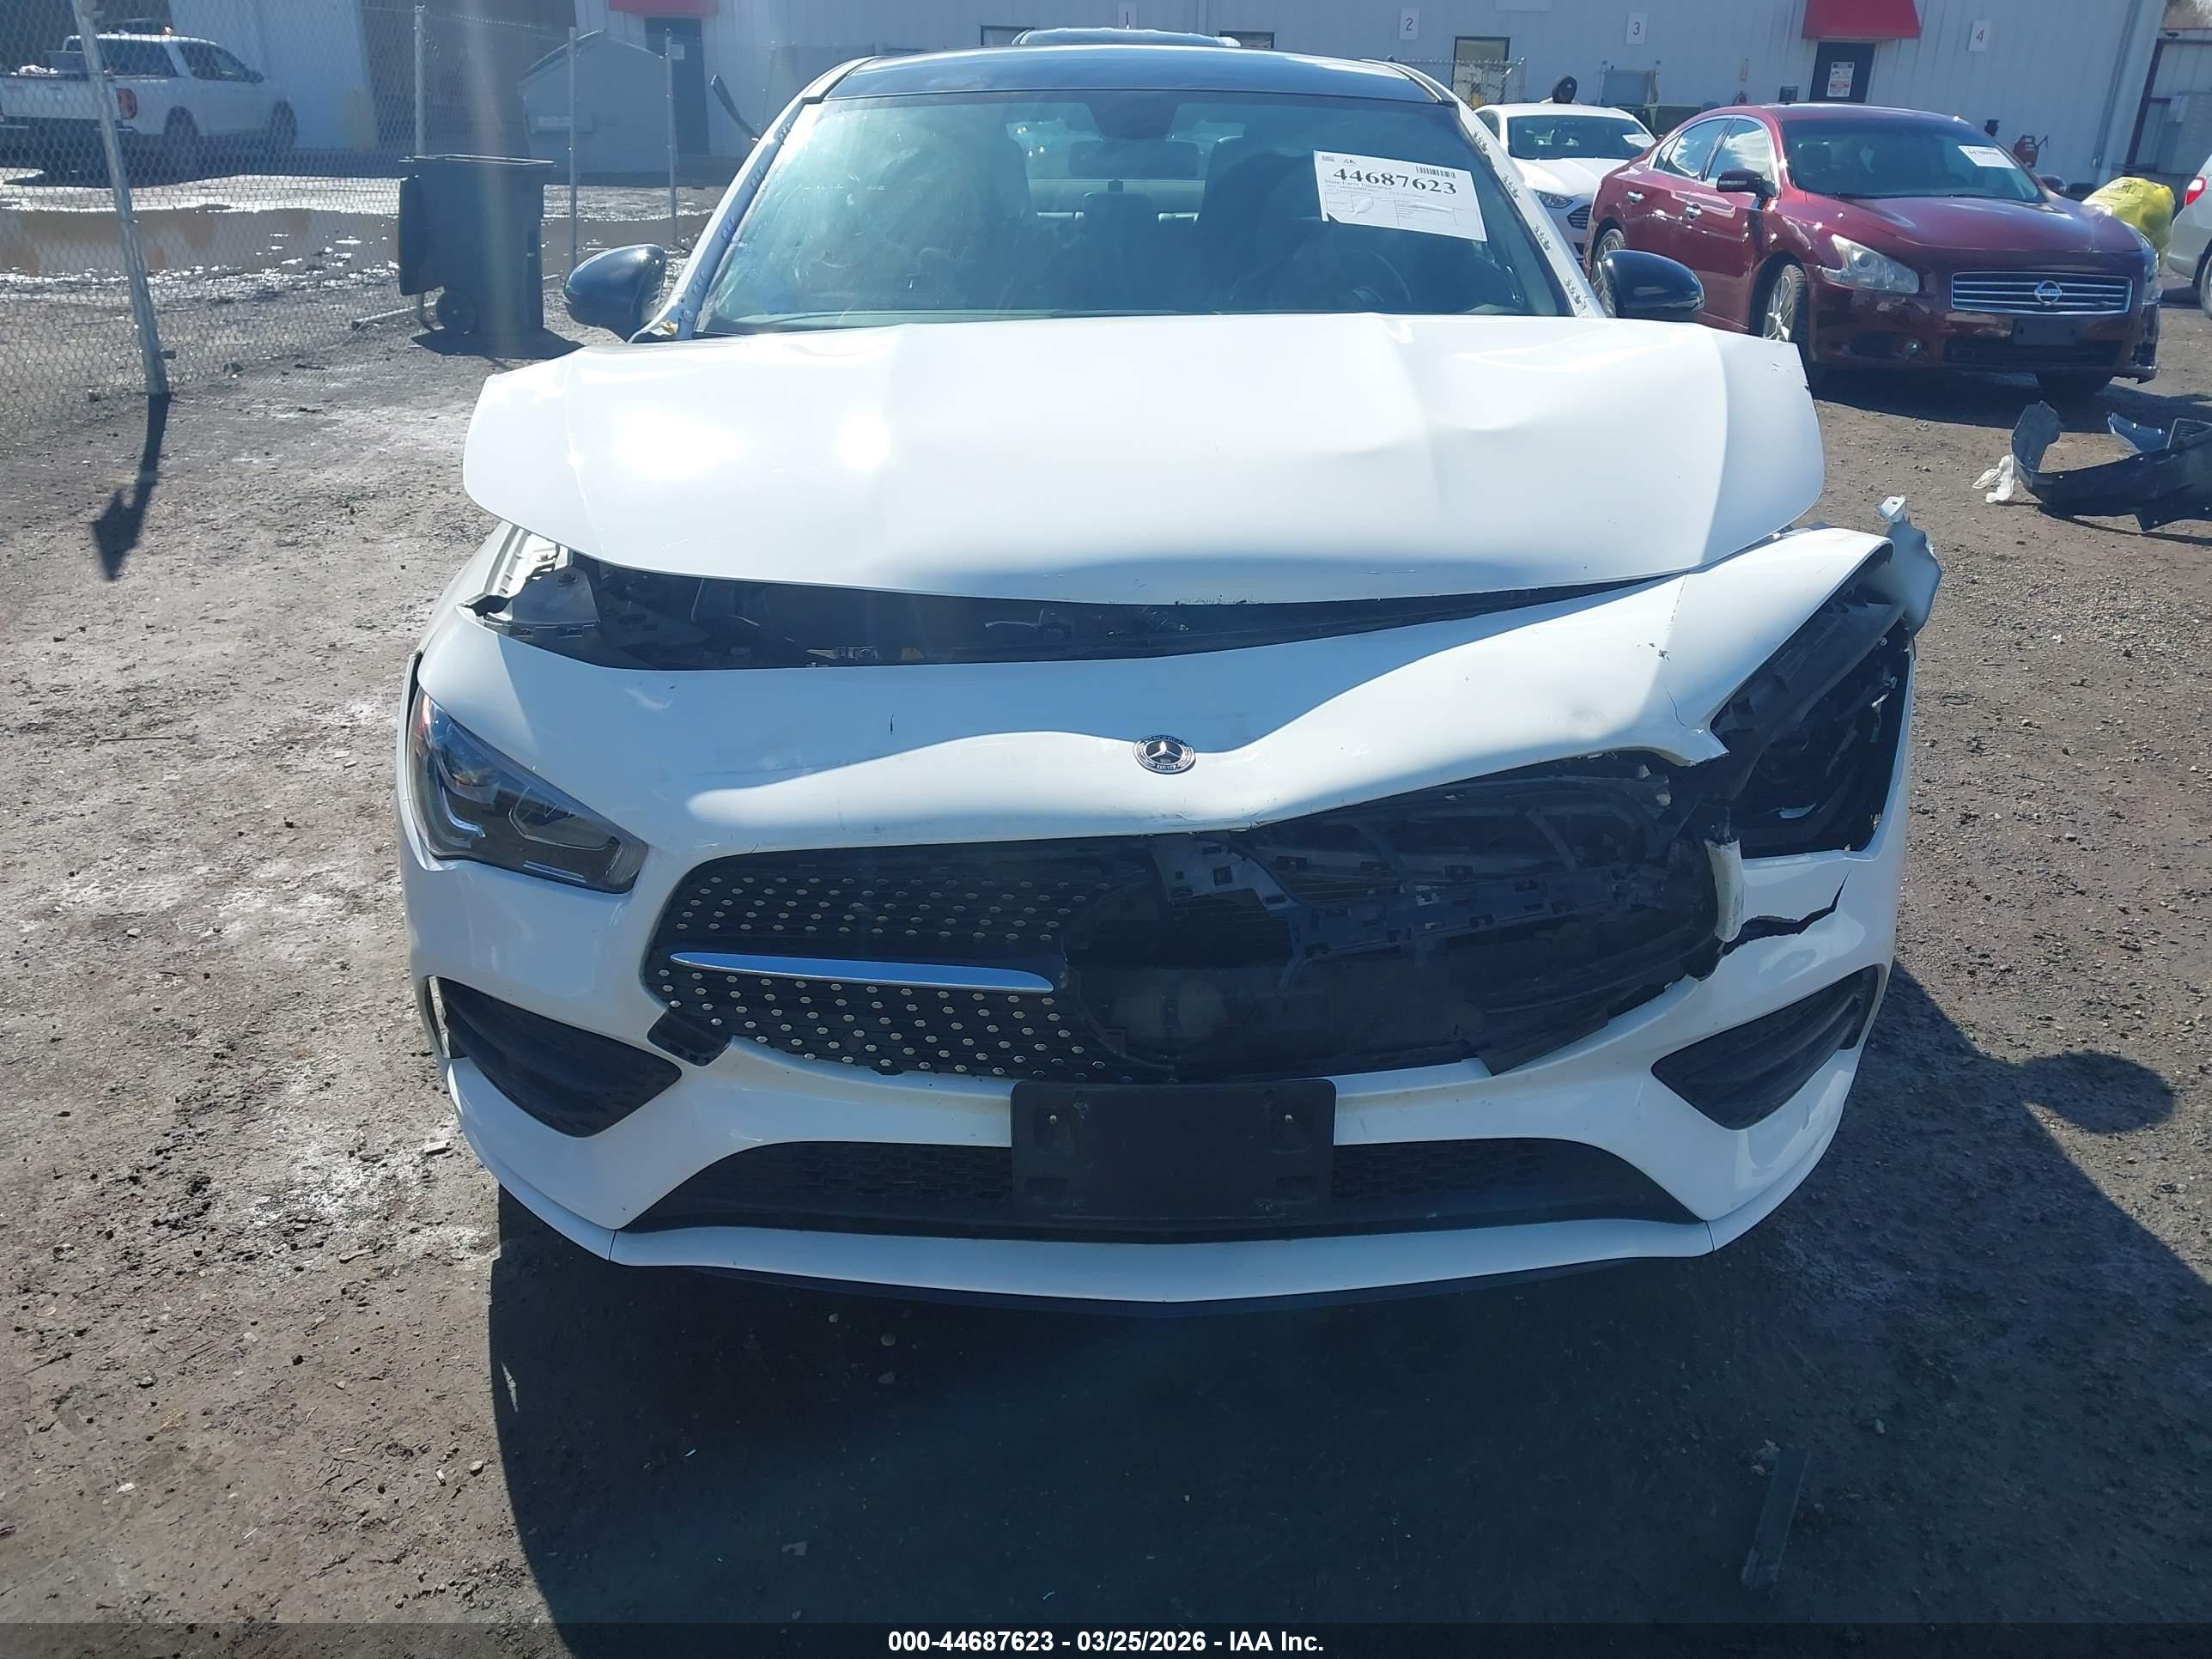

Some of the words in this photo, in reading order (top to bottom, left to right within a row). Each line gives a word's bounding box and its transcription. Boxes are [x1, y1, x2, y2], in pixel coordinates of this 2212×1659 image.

[1406, 17, 1414, 31] 2
[1633, 21, 1641, 36] 3
[1977, 29, 1984, 42] 4
[1334, 167, 1457, 195] 44687623
